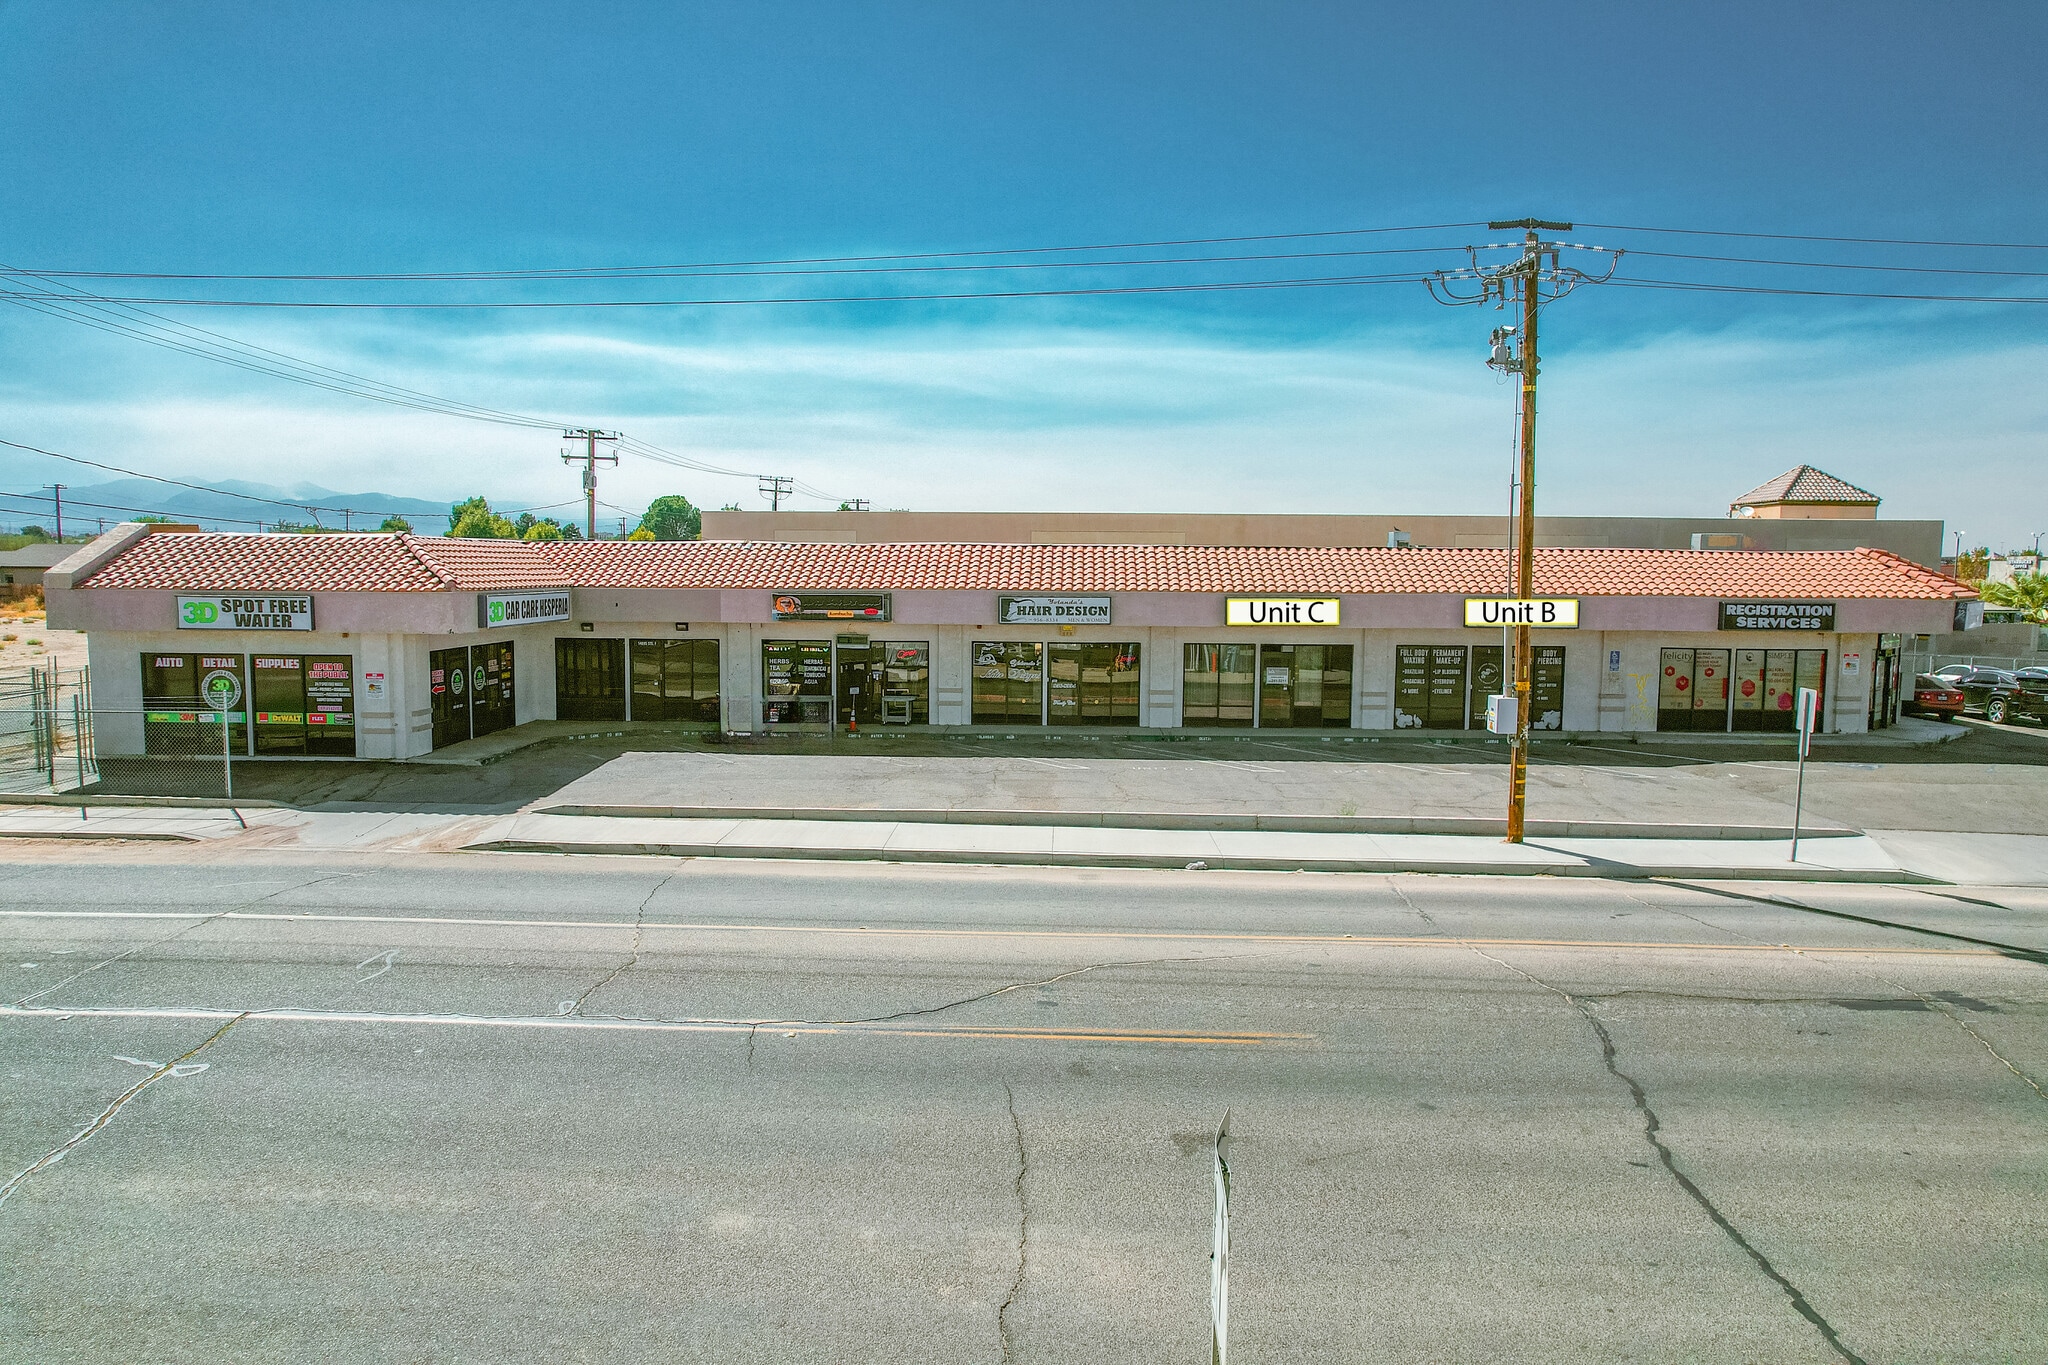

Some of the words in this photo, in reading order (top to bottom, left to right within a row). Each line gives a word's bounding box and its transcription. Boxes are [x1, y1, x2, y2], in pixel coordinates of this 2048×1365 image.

[221, 599, 265, 613] SPOT
[269, 600, 308, 613] FREE
[489, 601, 505, 622] 3D
[505, 601, 520, 620] CAR
[521, 599, 539, 619] CARE
[539, 597, 568, 617] HESPERIA
[1017, 605, 1052, 616] HAIR
[1055, 605, 1108, 616] DESIGN
[1726, 604, 1832, 617] REGISTRATION
[183, 602, 219, 623] 3D
[234, 613, 292, 628] WATER
[1736, 617, 1821, 629] SERVICES
[1542, 649, 1557, 657] BODY
[1663, 651, 1693, 661] felicity
[156, 657, 183, 667] AUTO
[202, 658, 237, 668] DETAIL
[255, 659, 299, 669] SUPPLIES
[1403, 656, 1425, 664] WAXING
[1436, 656, 1461, 664] MAKE-UP
[313, 663, 333, 671] OPEN
[333, 663, 343, 671] TO
[308, 670, 322, 678] THE
